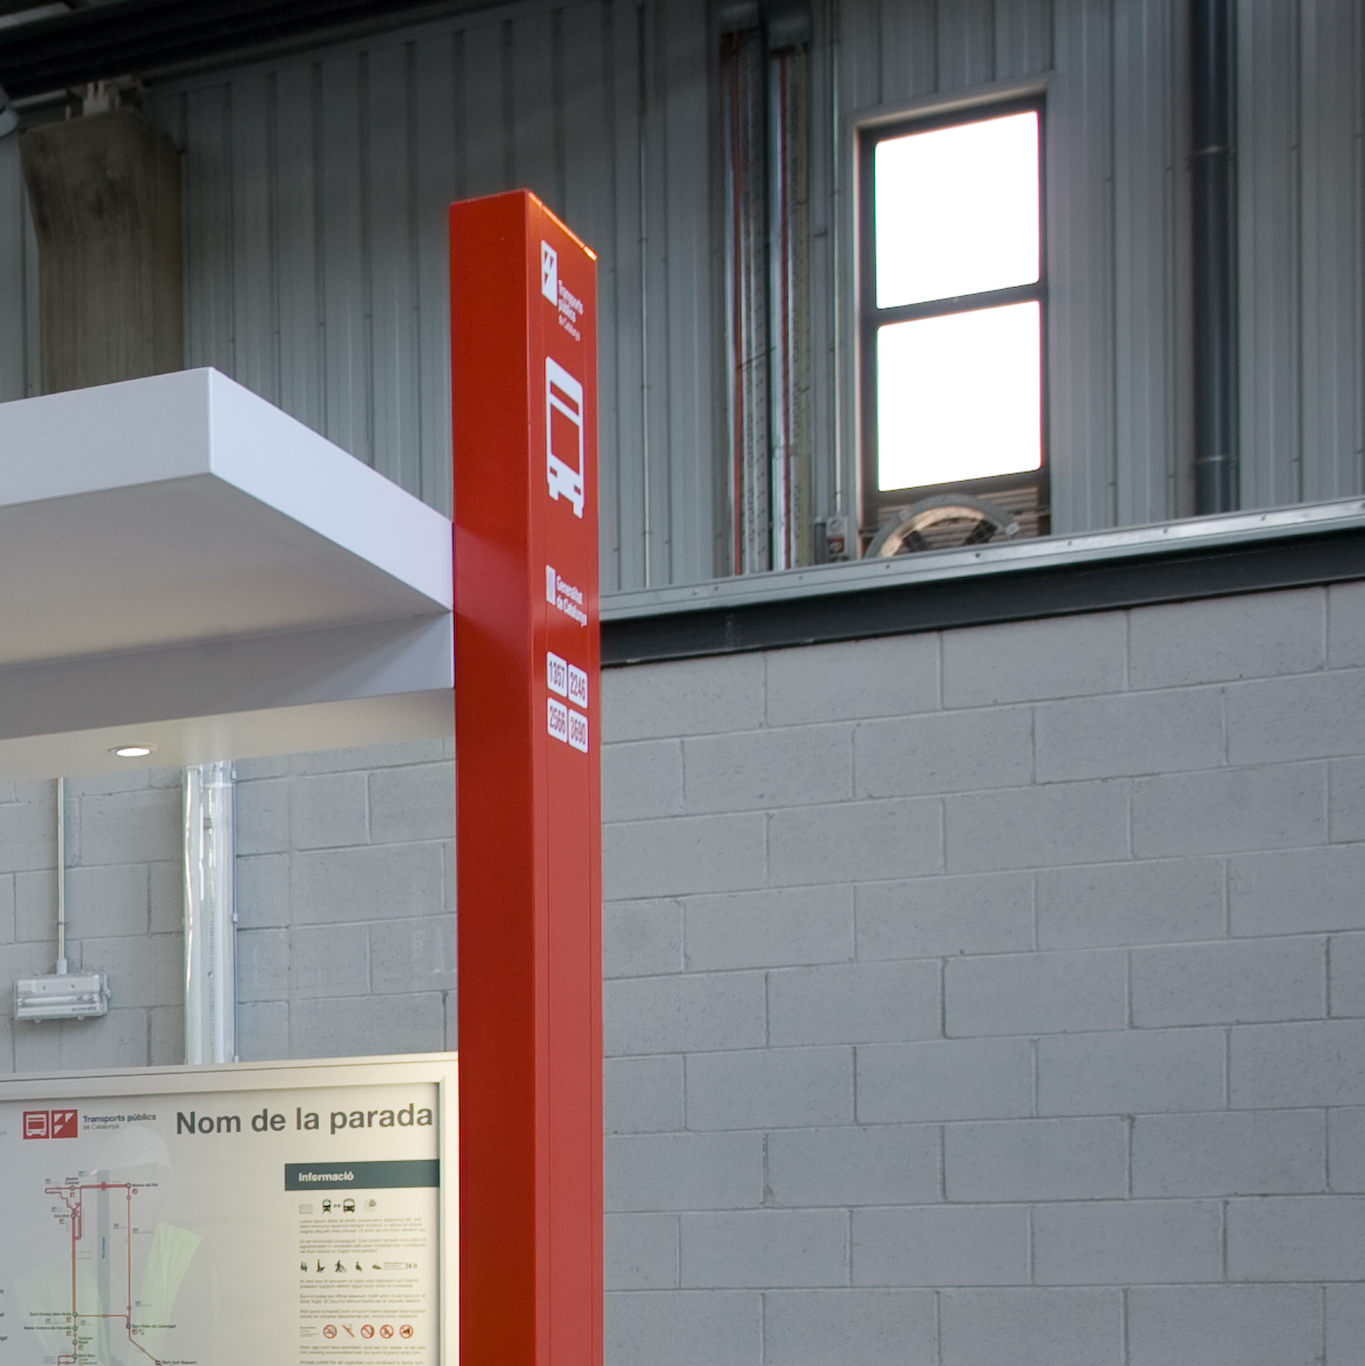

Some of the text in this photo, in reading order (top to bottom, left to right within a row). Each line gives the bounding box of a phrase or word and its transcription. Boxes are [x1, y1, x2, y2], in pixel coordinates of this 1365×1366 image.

[549, 660, 586, 702] 1357 2246
[82, 1112, 157, 1124] Transports públics
[176, 1103, 433, 1135] Nom de la parada
[92, 1122, 120, 1131] Catalunya
[298, 1170, 354, 1182] Informació
